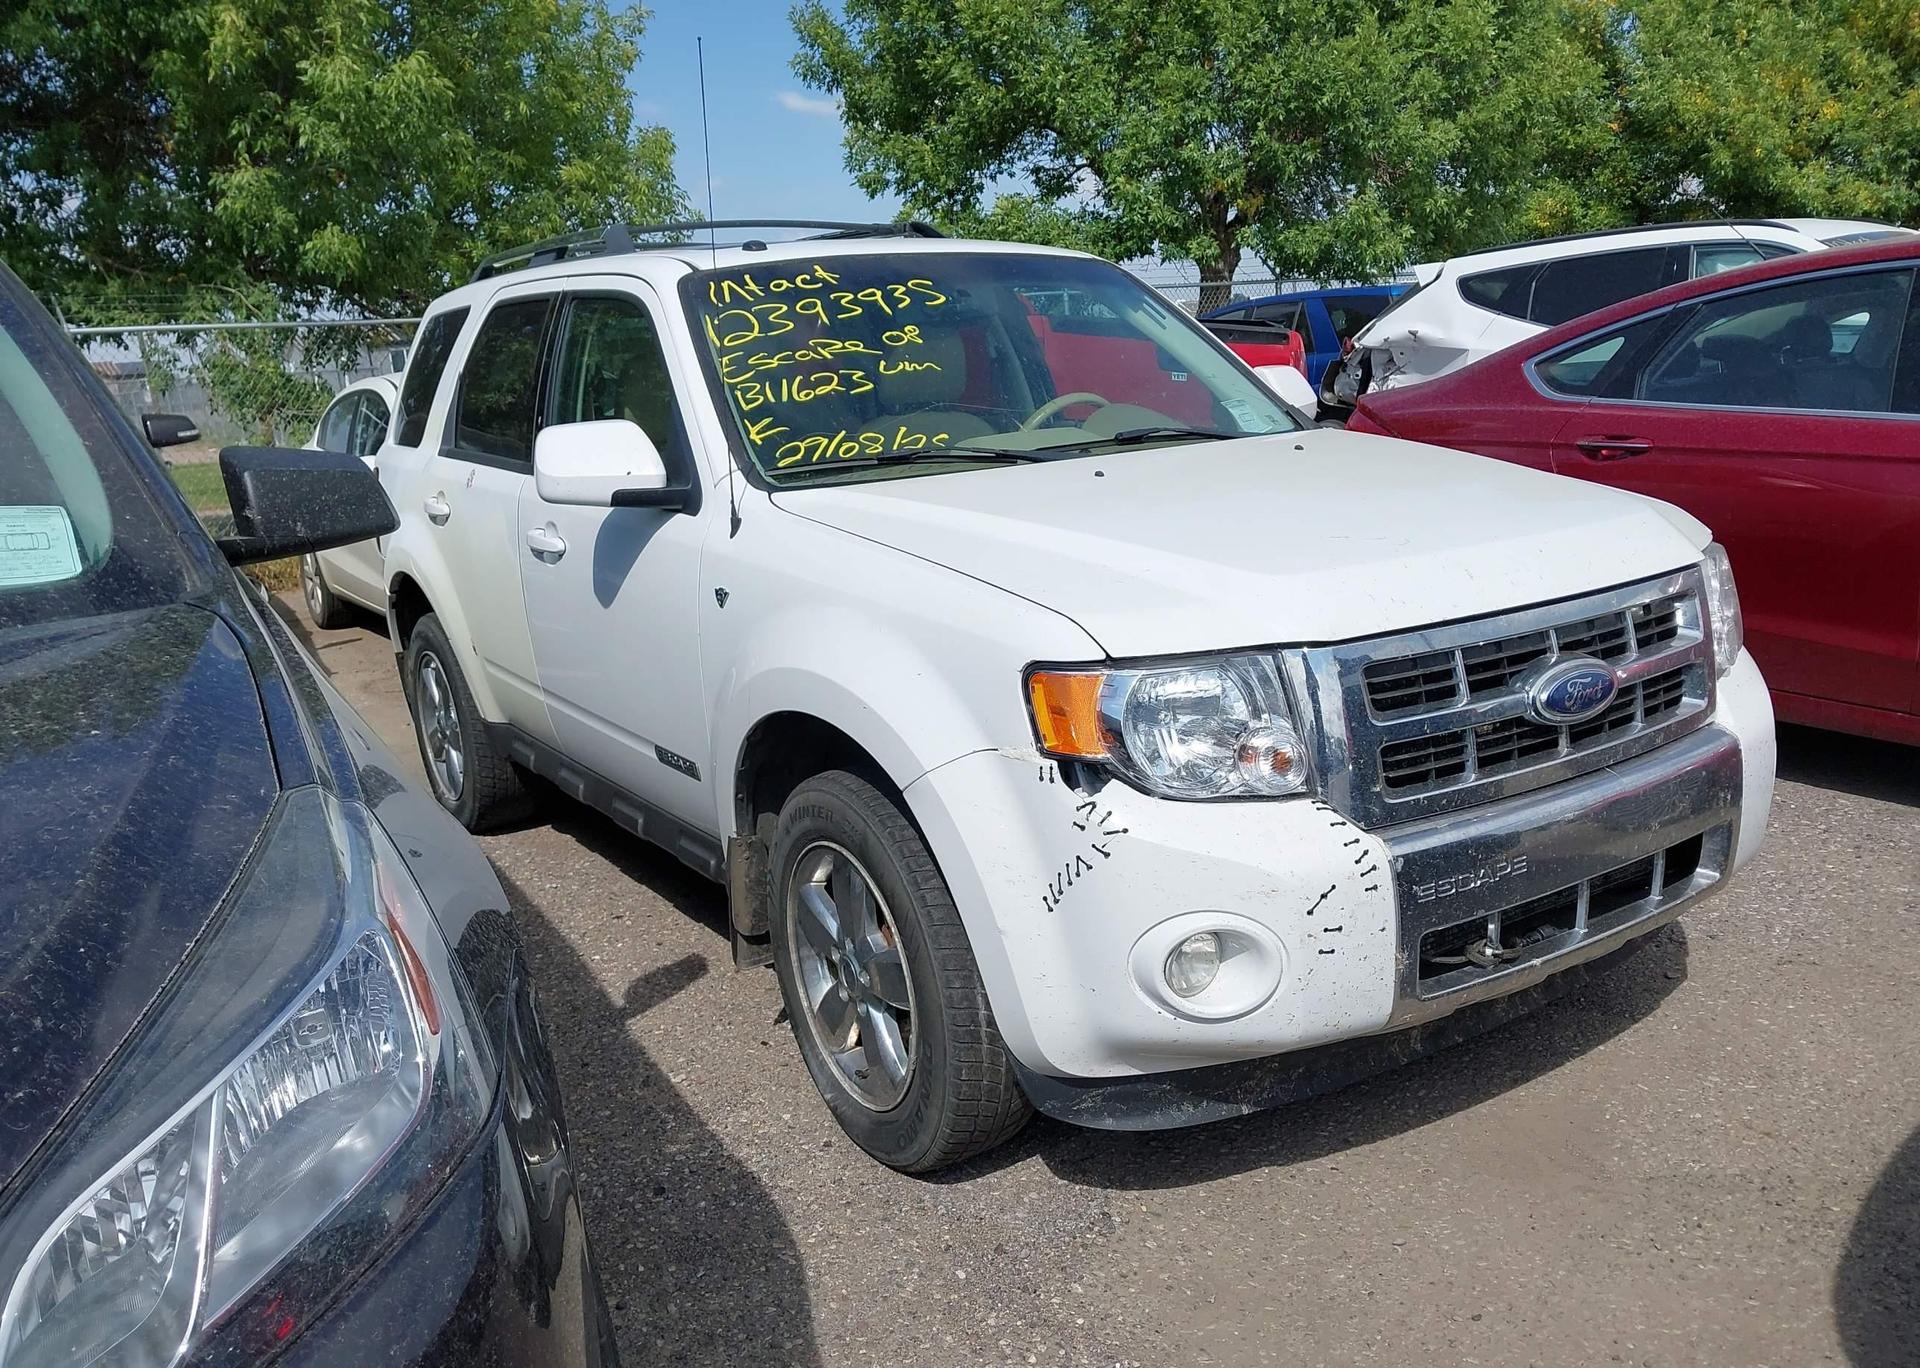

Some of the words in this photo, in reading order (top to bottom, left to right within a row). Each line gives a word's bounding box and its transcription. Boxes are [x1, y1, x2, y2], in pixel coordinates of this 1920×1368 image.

[882, 325, 923, 346] 08
[1564, 676, 1608, 707] Ford
[789, 804, 834, 825] WINTER
[1416, 855, 1528, 903] ESCAPE
